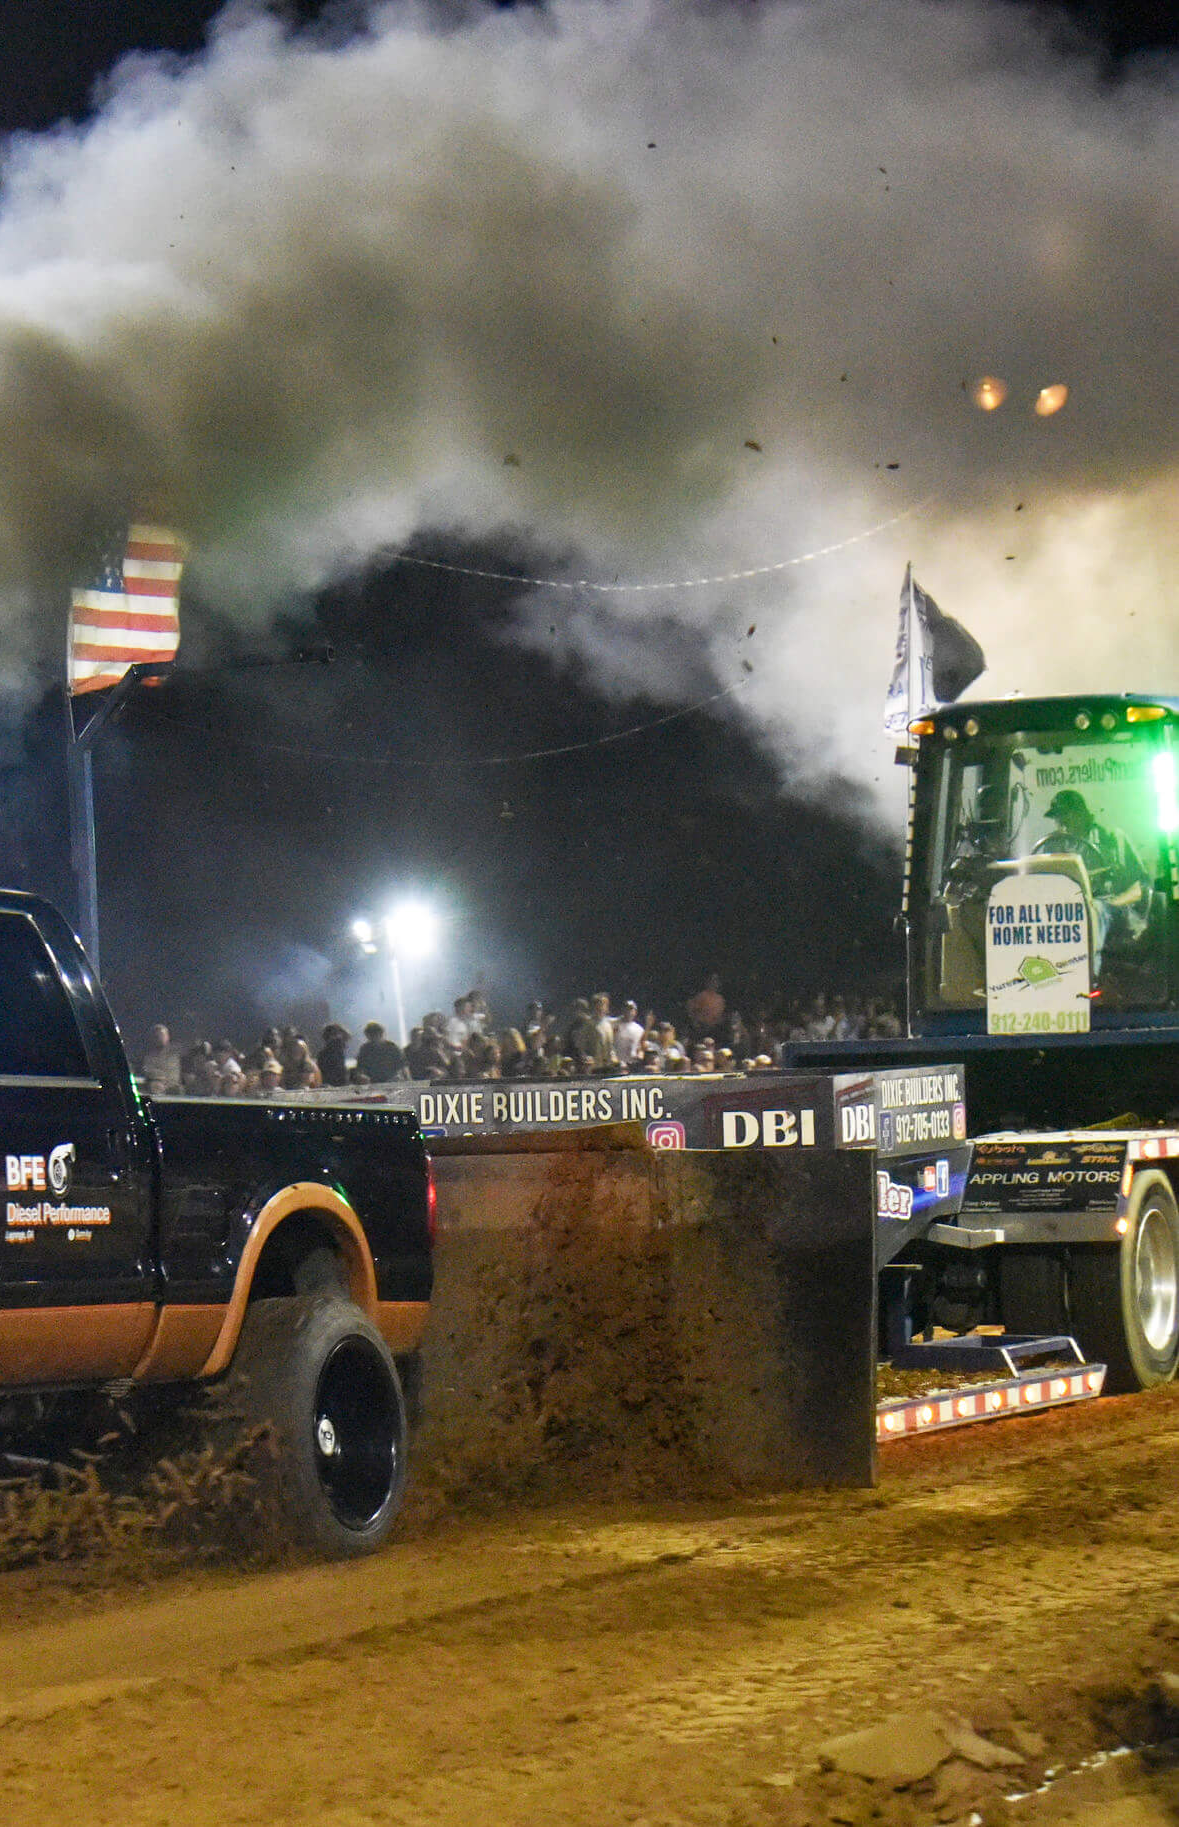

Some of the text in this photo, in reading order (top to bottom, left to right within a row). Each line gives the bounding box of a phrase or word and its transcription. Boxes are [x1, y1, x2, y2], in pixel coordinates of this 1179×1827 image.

[989, 902, 1084, 924] FOR ALL YOUR
[993, 924, 1082, 945] HOME NEEDS
[420, 1087, 672, 1125] DIXIE BUILDERS INC.
[881, 1073, 962, 1108] DIXIE BUILDERS INC.
[723, 1110, 815, 1148] DBI
[842, 1103, 876, 1143] DBI
[5, 1155, 47, 1191] BFE
[969, 1171, 1121, 1185] APPLING MOTORS
[6, 1202, 111, 1225] Diesel Performance
